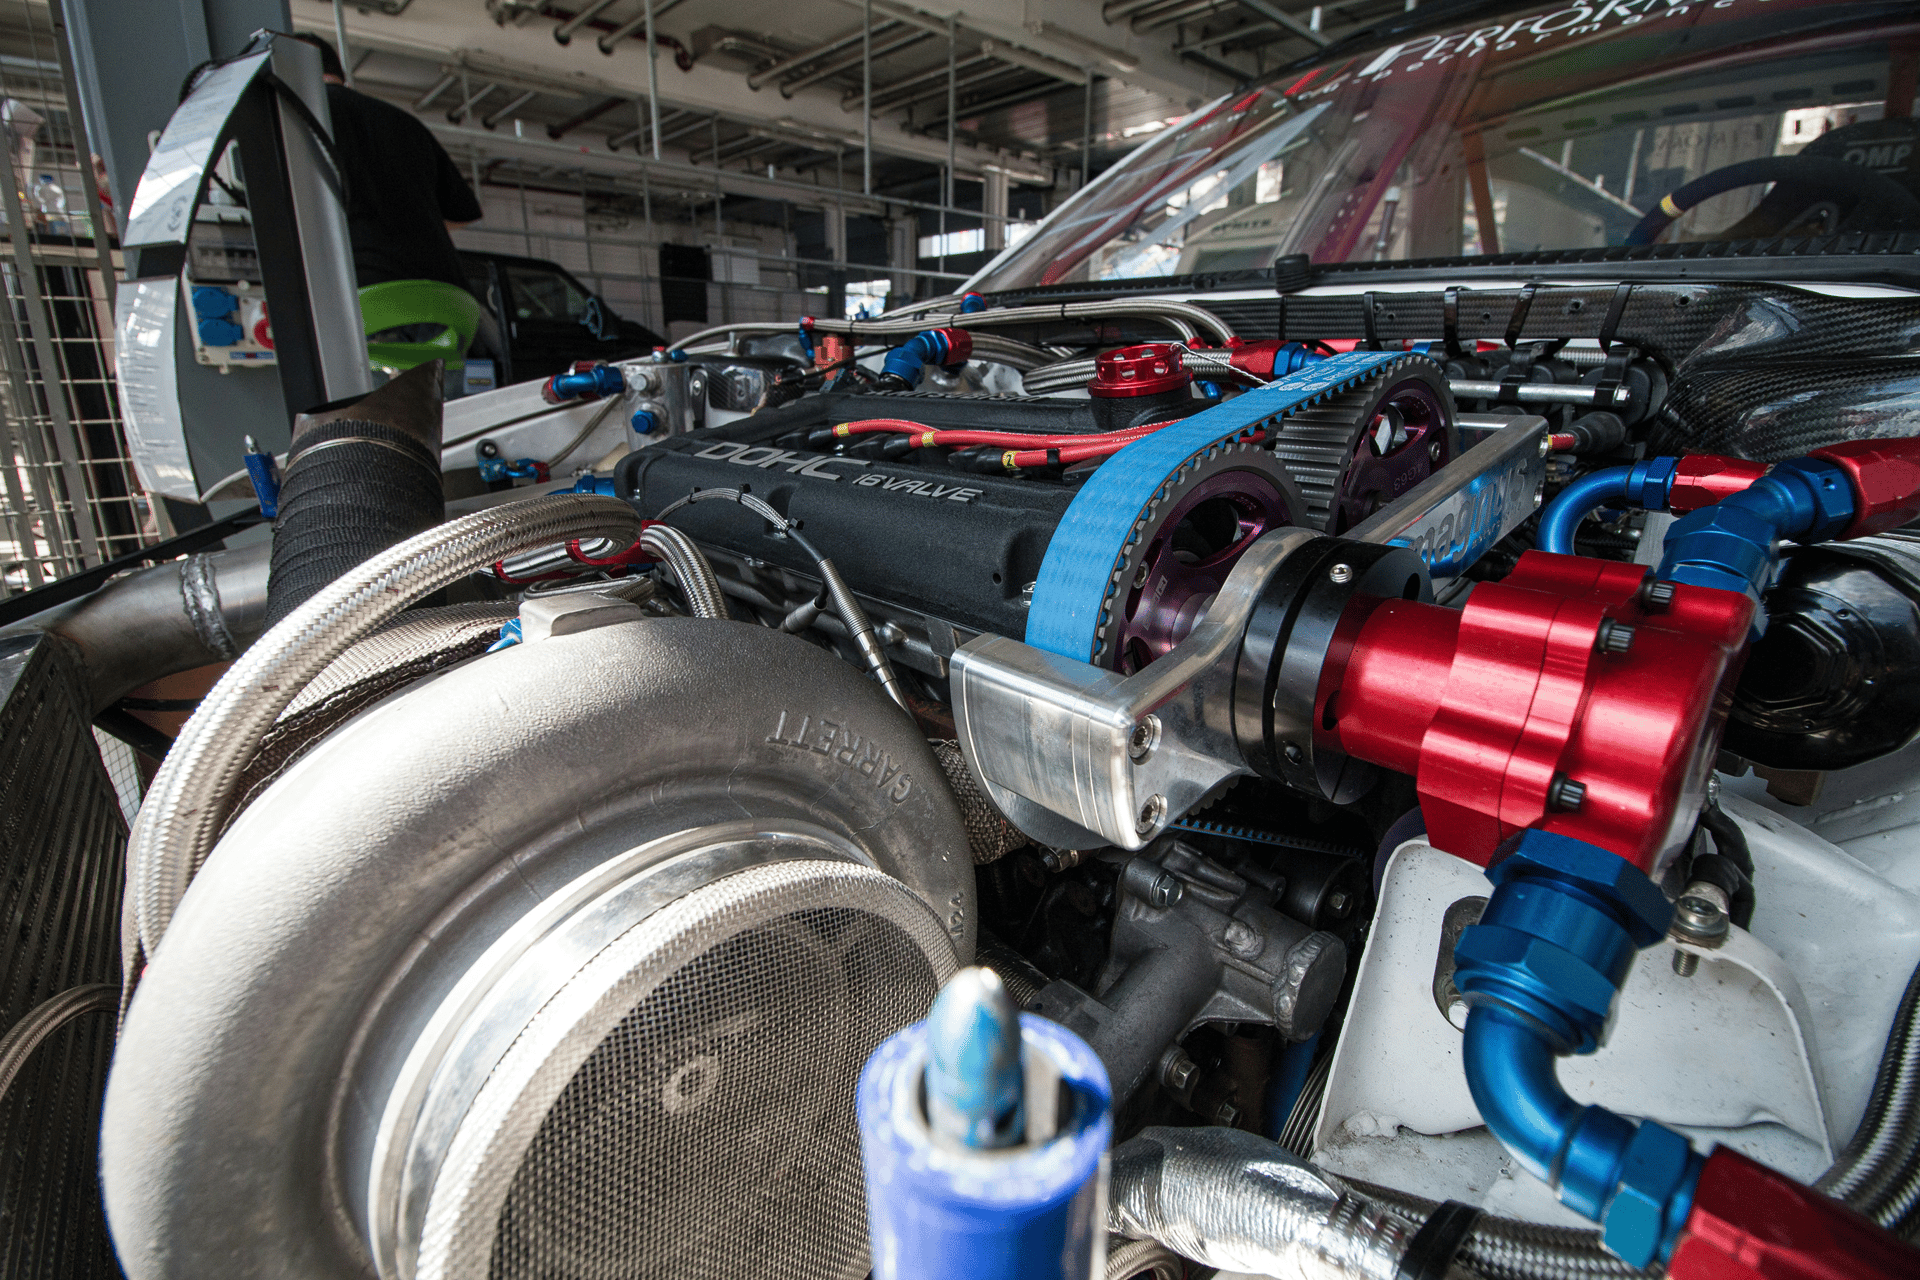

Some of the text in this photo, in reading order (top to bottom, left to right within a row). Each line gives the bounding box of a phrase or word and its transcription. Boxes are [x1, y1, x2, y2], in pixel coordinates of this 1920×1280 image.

[1842, 144, 1913, 167] OMP
[693, 441, 871, 481] DOHC
[765, 709, 914, 804] GARRETT
